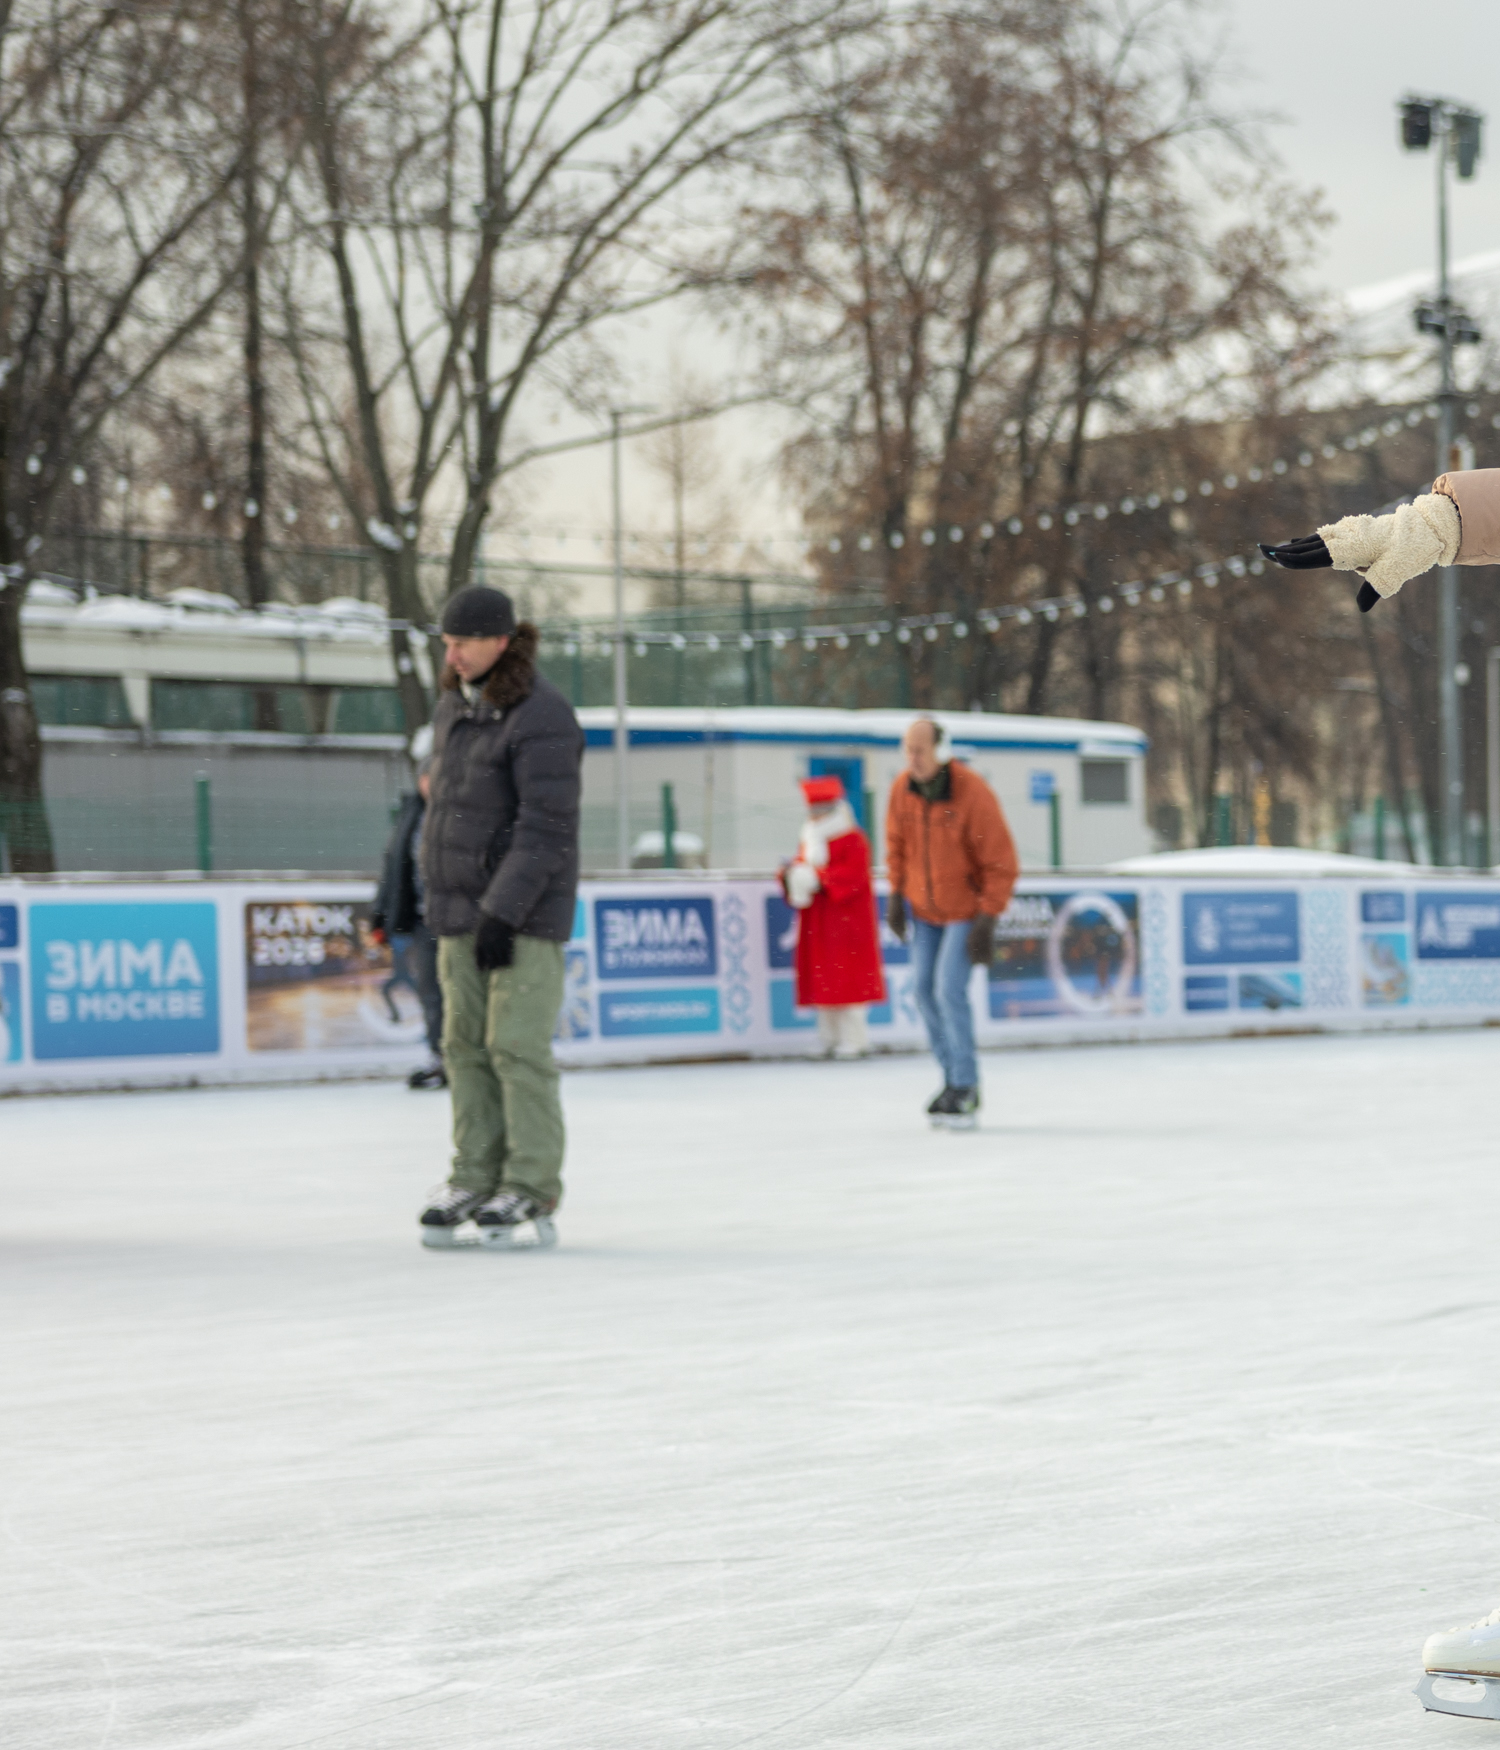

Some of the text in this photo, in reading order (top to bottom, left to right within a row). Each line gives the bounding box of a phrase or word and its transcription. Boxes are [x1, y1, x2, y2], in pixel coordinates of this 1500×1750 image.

[252, 905, 354, 936] КАТОК
[603, 908, 708, 947] ЗИМА
[46, 938, 204, 988] ЗИМА
[252, 937, 327, 966] 2026
[47, 989, 205, 1022] В МОСКВЕ
